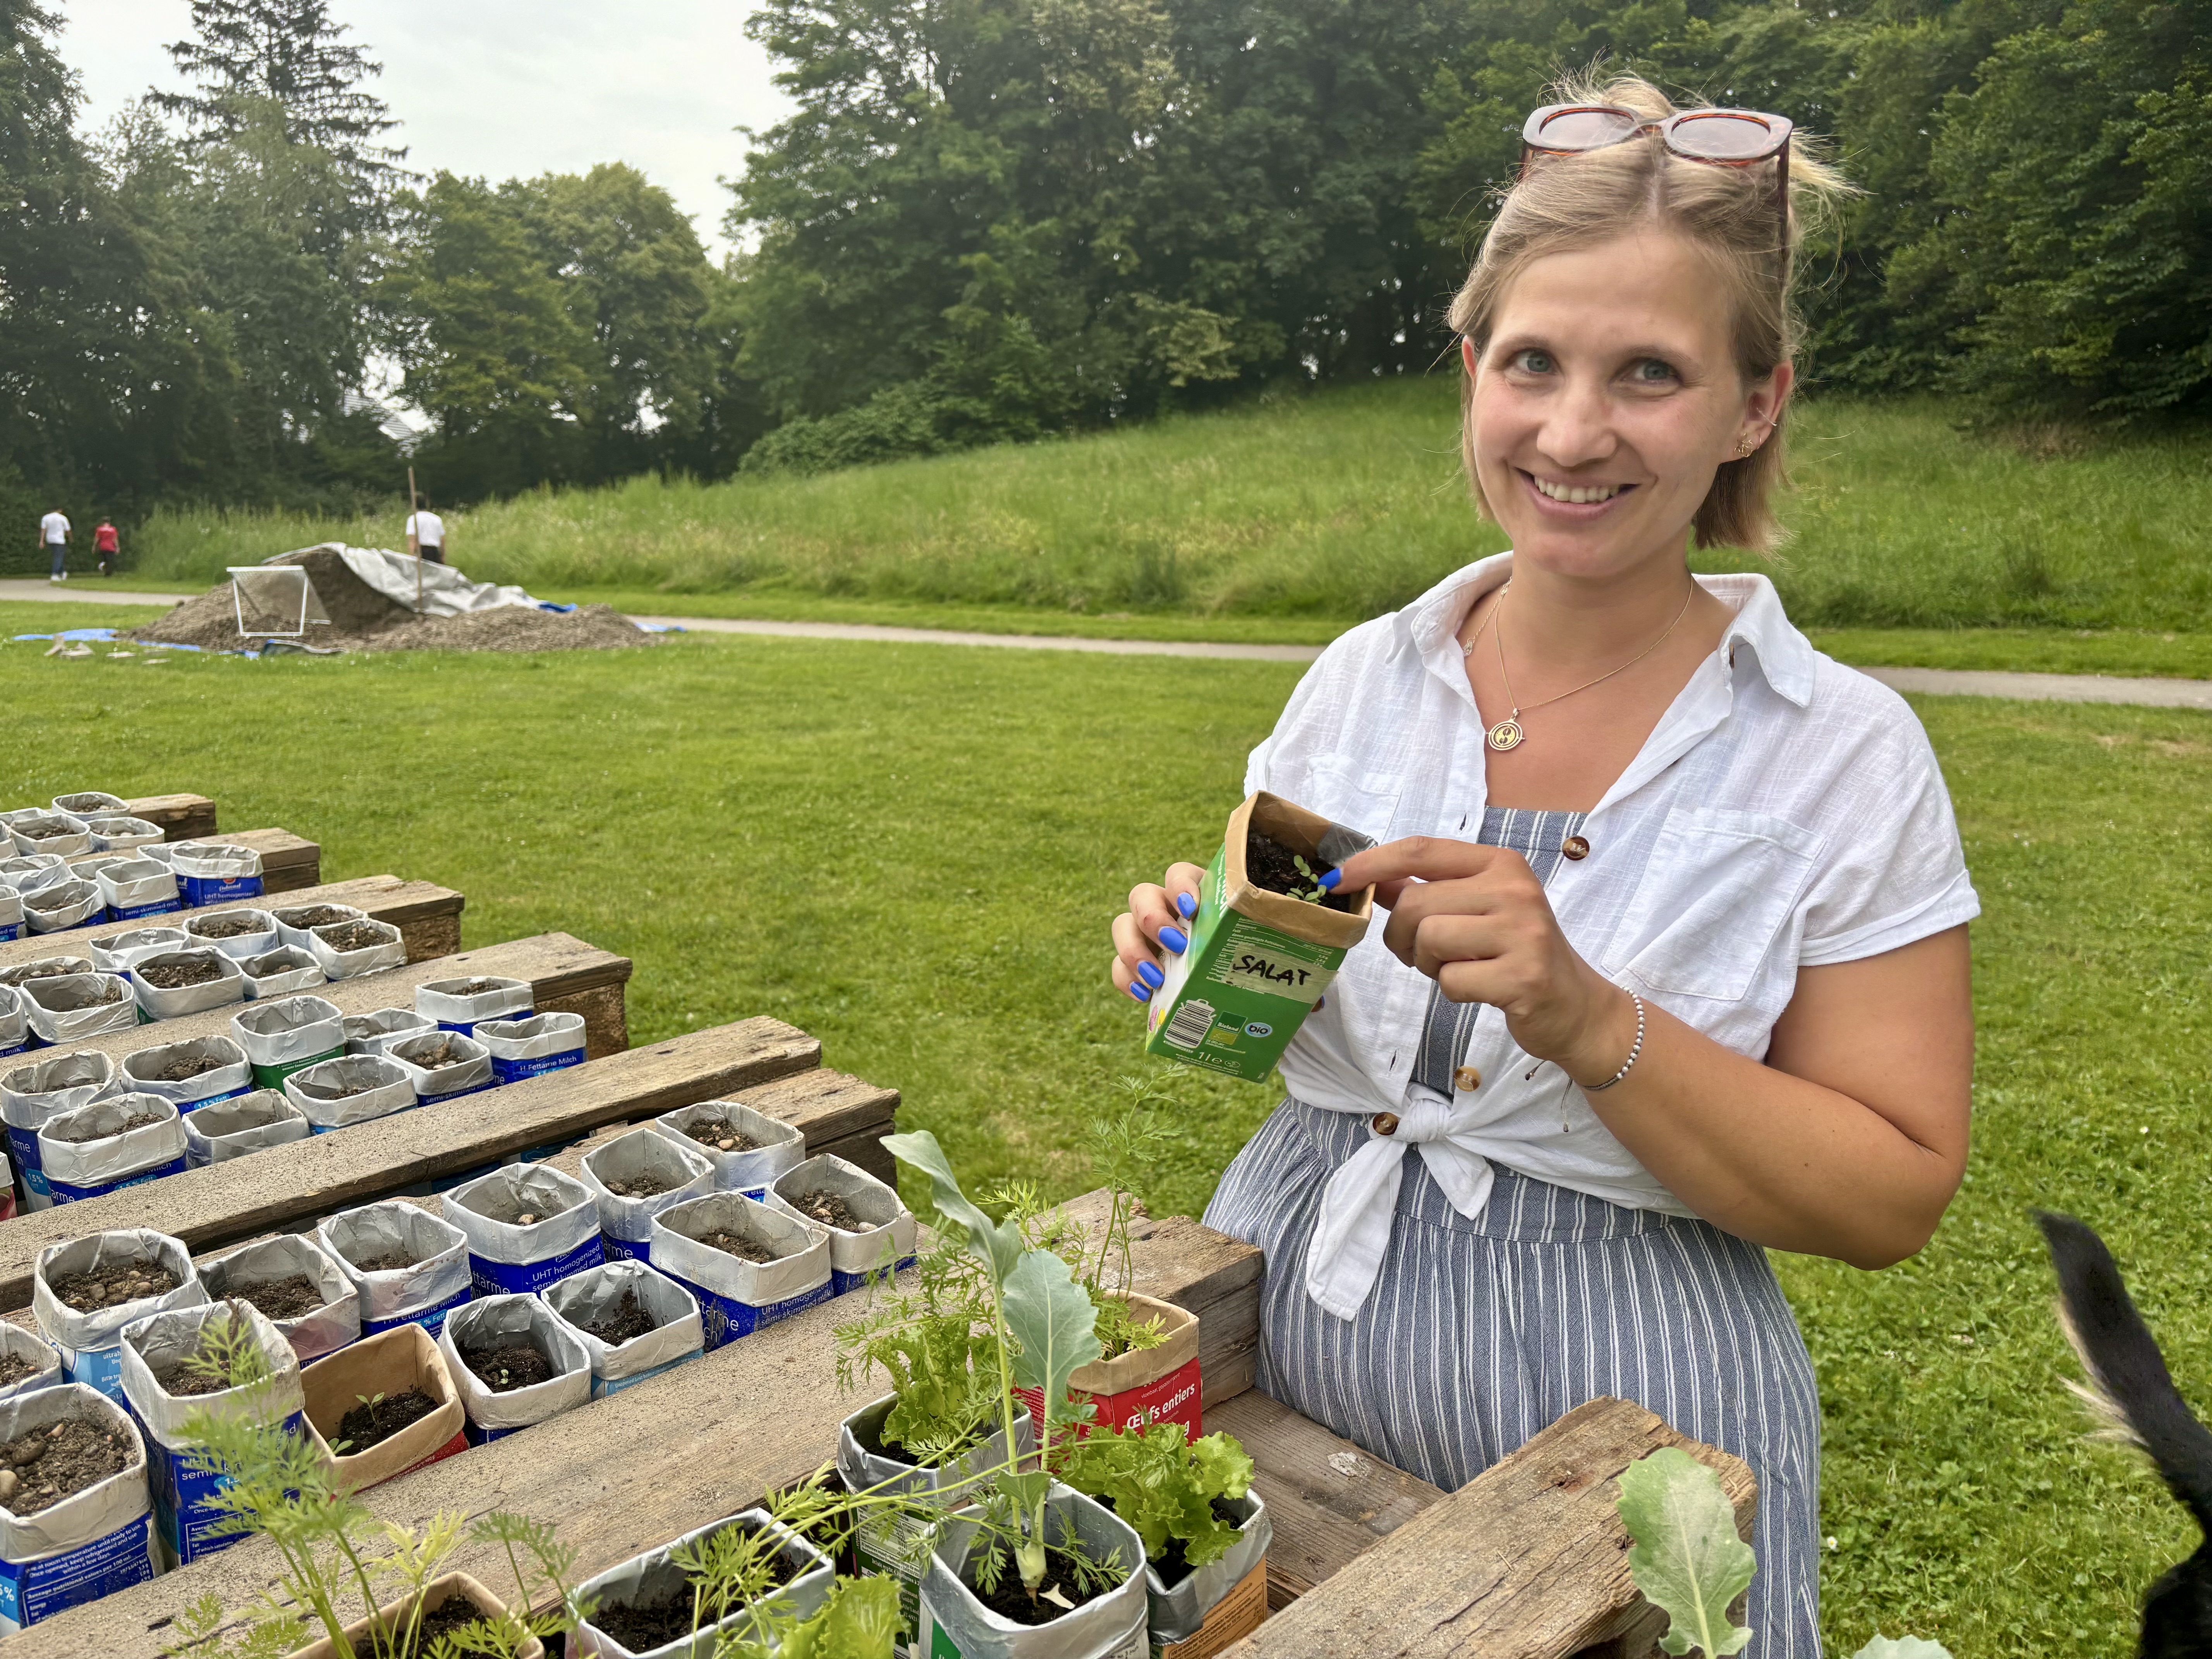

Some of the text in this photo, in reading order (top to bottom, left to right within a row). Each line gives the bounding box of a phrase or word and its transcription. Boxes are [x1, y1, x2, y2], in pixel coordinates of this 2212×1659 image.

[125, 903, 165, 915] semi-skimmed
[1233, 955, 1311, 986] SALAT
[1218, 1022, 1239, 1032] Bioland
[1249, 1025, 1268, 1034] bio
[5, 1047, 21, 1055] milk
[558, 1055, 577, 1066] Milch
[532, 1268, 552, 1281] UHT
[554, 1242, 600, 1274] homogenized
[589, 1252, 602, 1266] milk
[472, 1271, 510, 1295] ttarme
[433, 1312, 445, 1322] Fett
[761, 1303, 779, 1316] UHT
[1162, 1383, 1195, 1413] entiers
[29, 1570, 44, 1578] Once
[70, 1557, 84, 1567] keep
[84, 1544, 117, 1560] refrigerated
[117, 1538, 128, 1546] and
[128, 1532, 137, 1541] use
[45, 1559, 62, 1568] room
[61, 1545, 96, 1562] temperature
[98, 1538, 110, 1549] until
[111, 1533, 125, 1544] ready
[62, 1564, 81, 1575] within
[86, 1558, 97, 1566] few
[53, 1576, 83, 1592] nutritional
[84, 1569, 103, 1580] values
[103, 1565, 112, 1573] per
